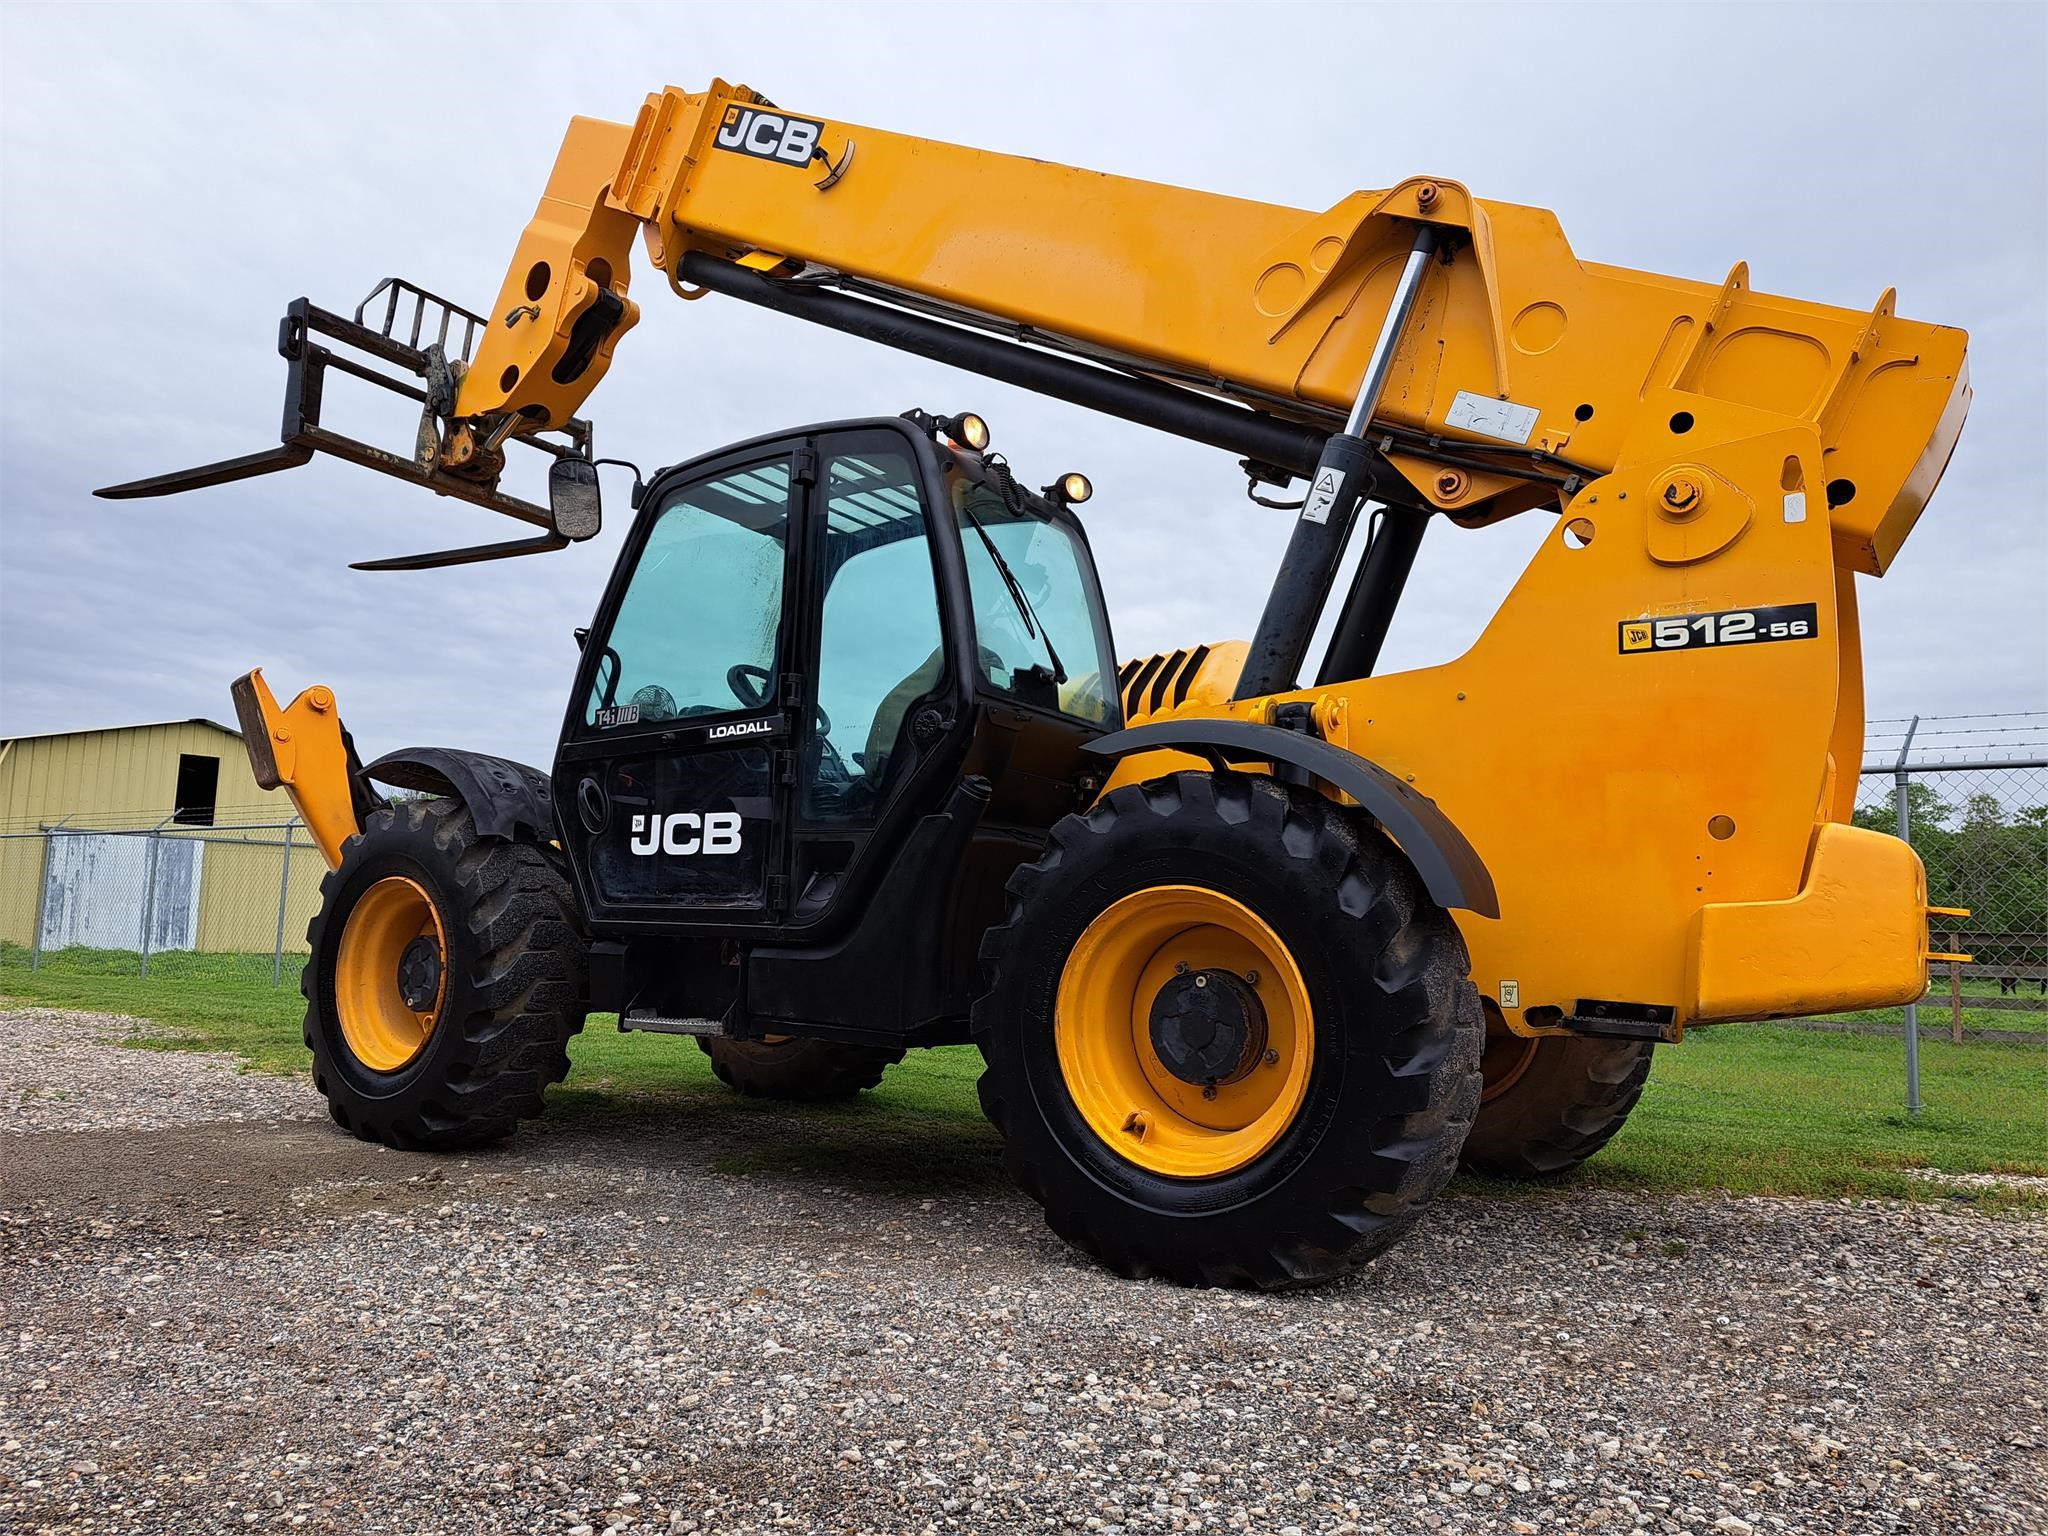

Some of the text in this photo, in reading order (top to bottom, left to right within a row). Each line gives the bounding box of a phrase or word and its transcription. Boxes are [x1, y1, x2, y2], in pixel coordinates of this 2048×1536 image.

[718, 111, 818, 163] JCB
[1630, 612, 1809, 648] JCB 512-56
[709, 720, 772, 739] LOADALL
[631, 812, 742, 856] JCB
